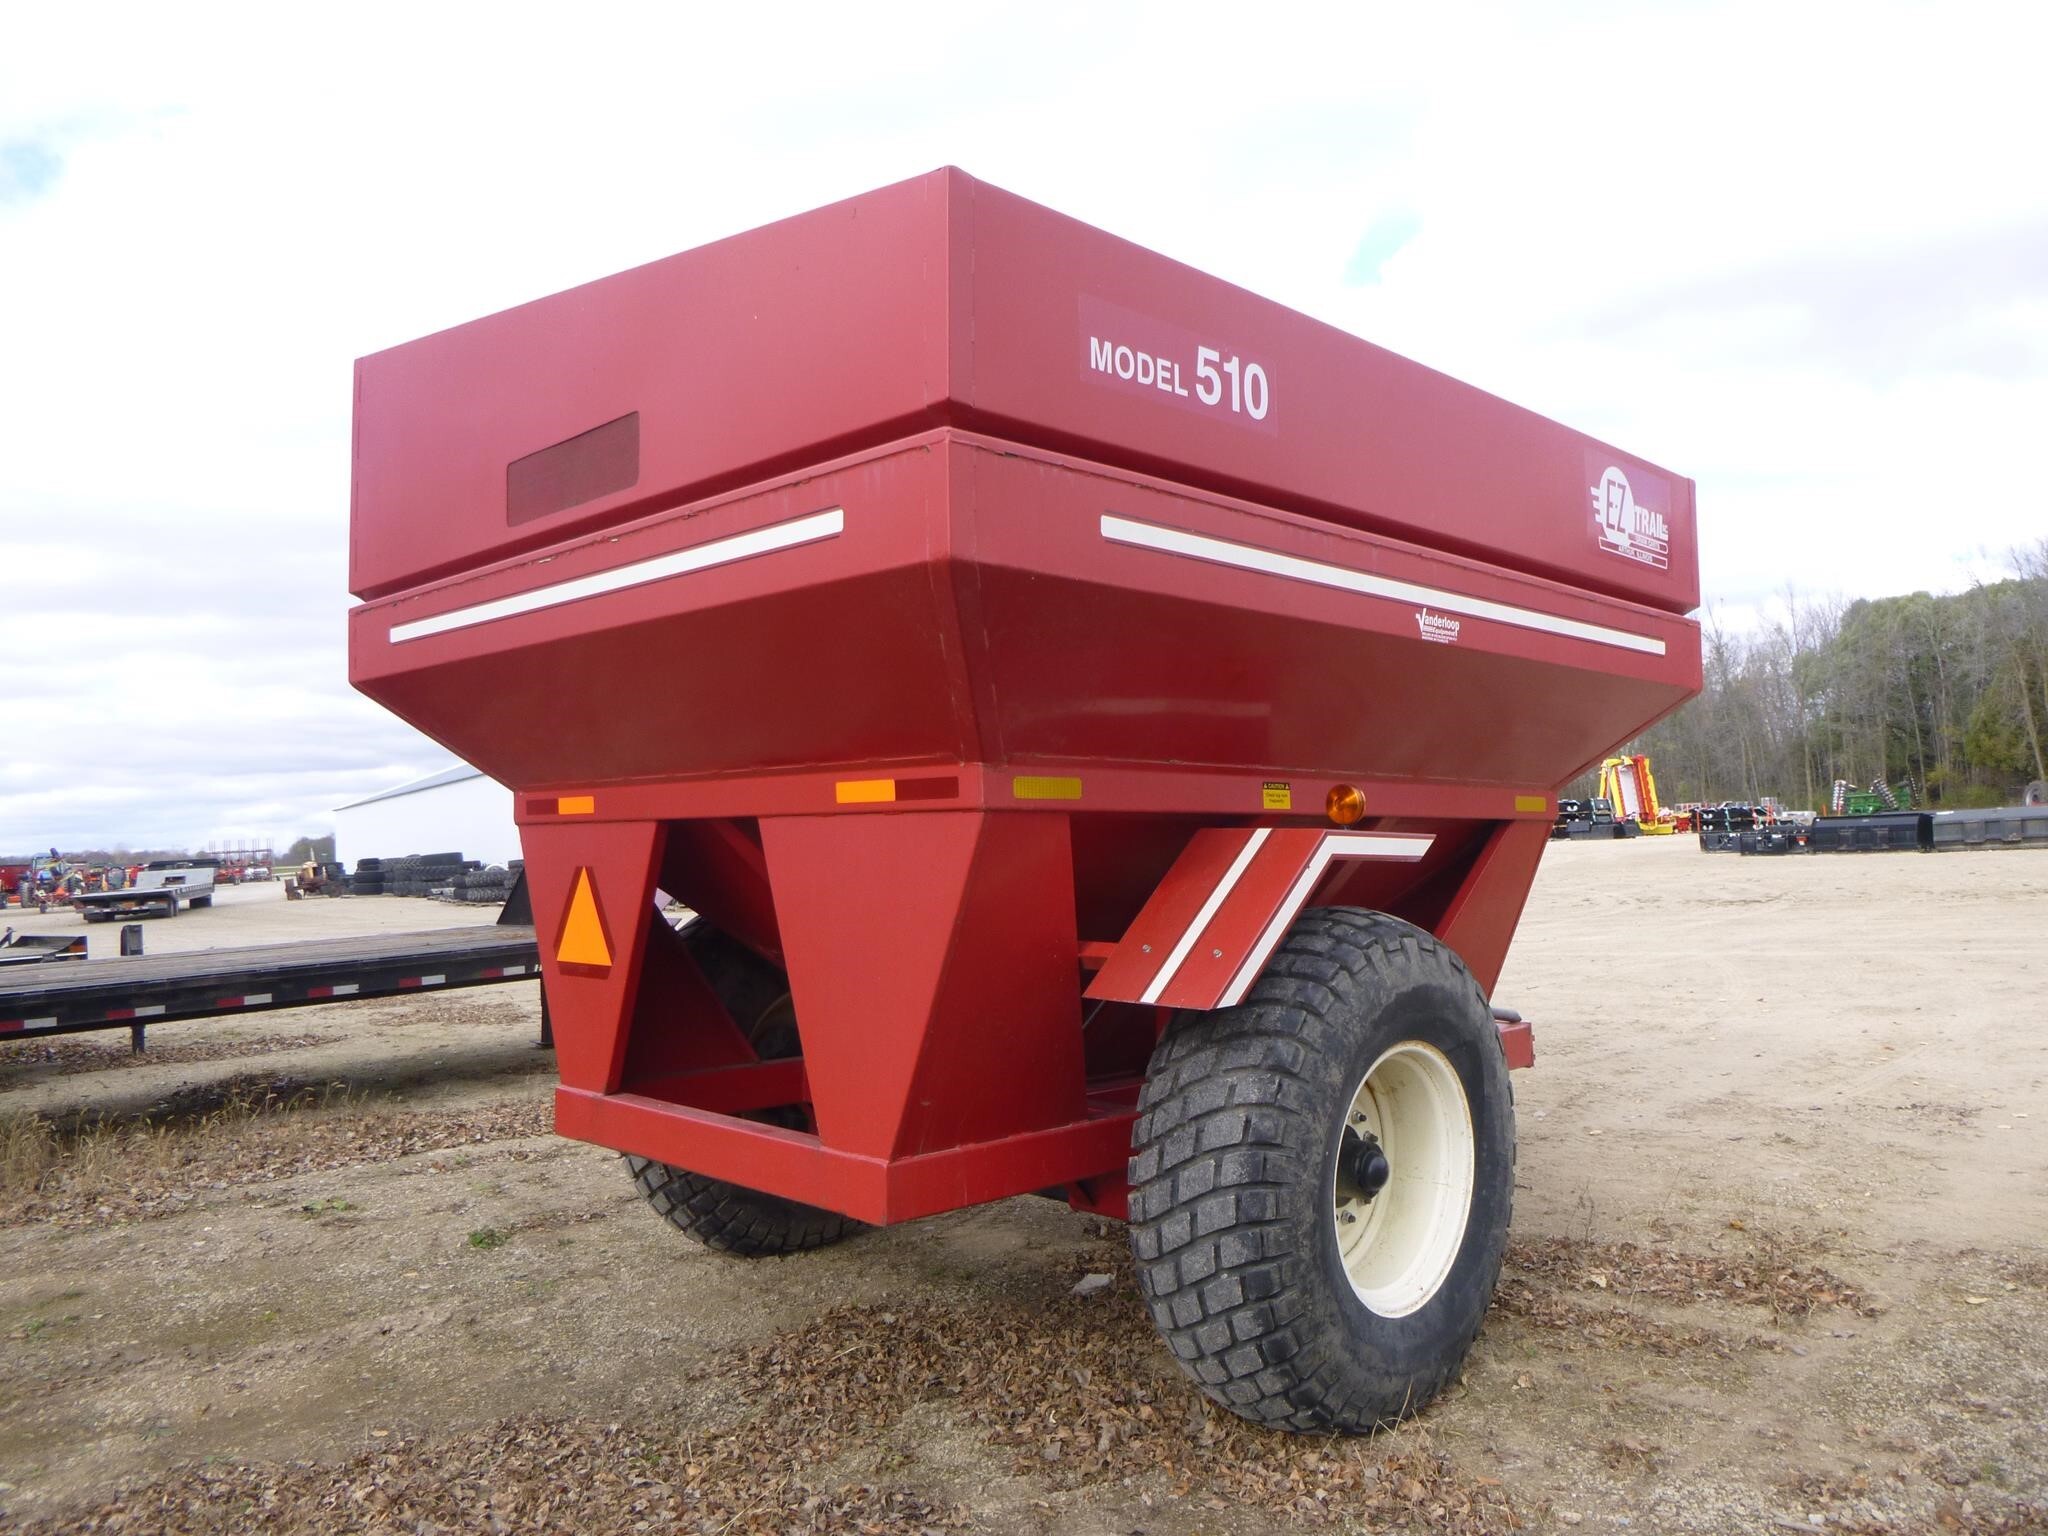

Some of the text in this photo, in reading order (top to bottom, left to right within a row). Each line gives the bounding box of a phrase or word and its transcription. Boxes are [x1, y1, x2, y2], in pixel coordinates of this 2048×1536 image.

[1090, 336, 1269, 421] MODEL 510
[1634, 504, 1668, 541] TRAIL
[1415, 607, 1460, 637] Vanderloop
